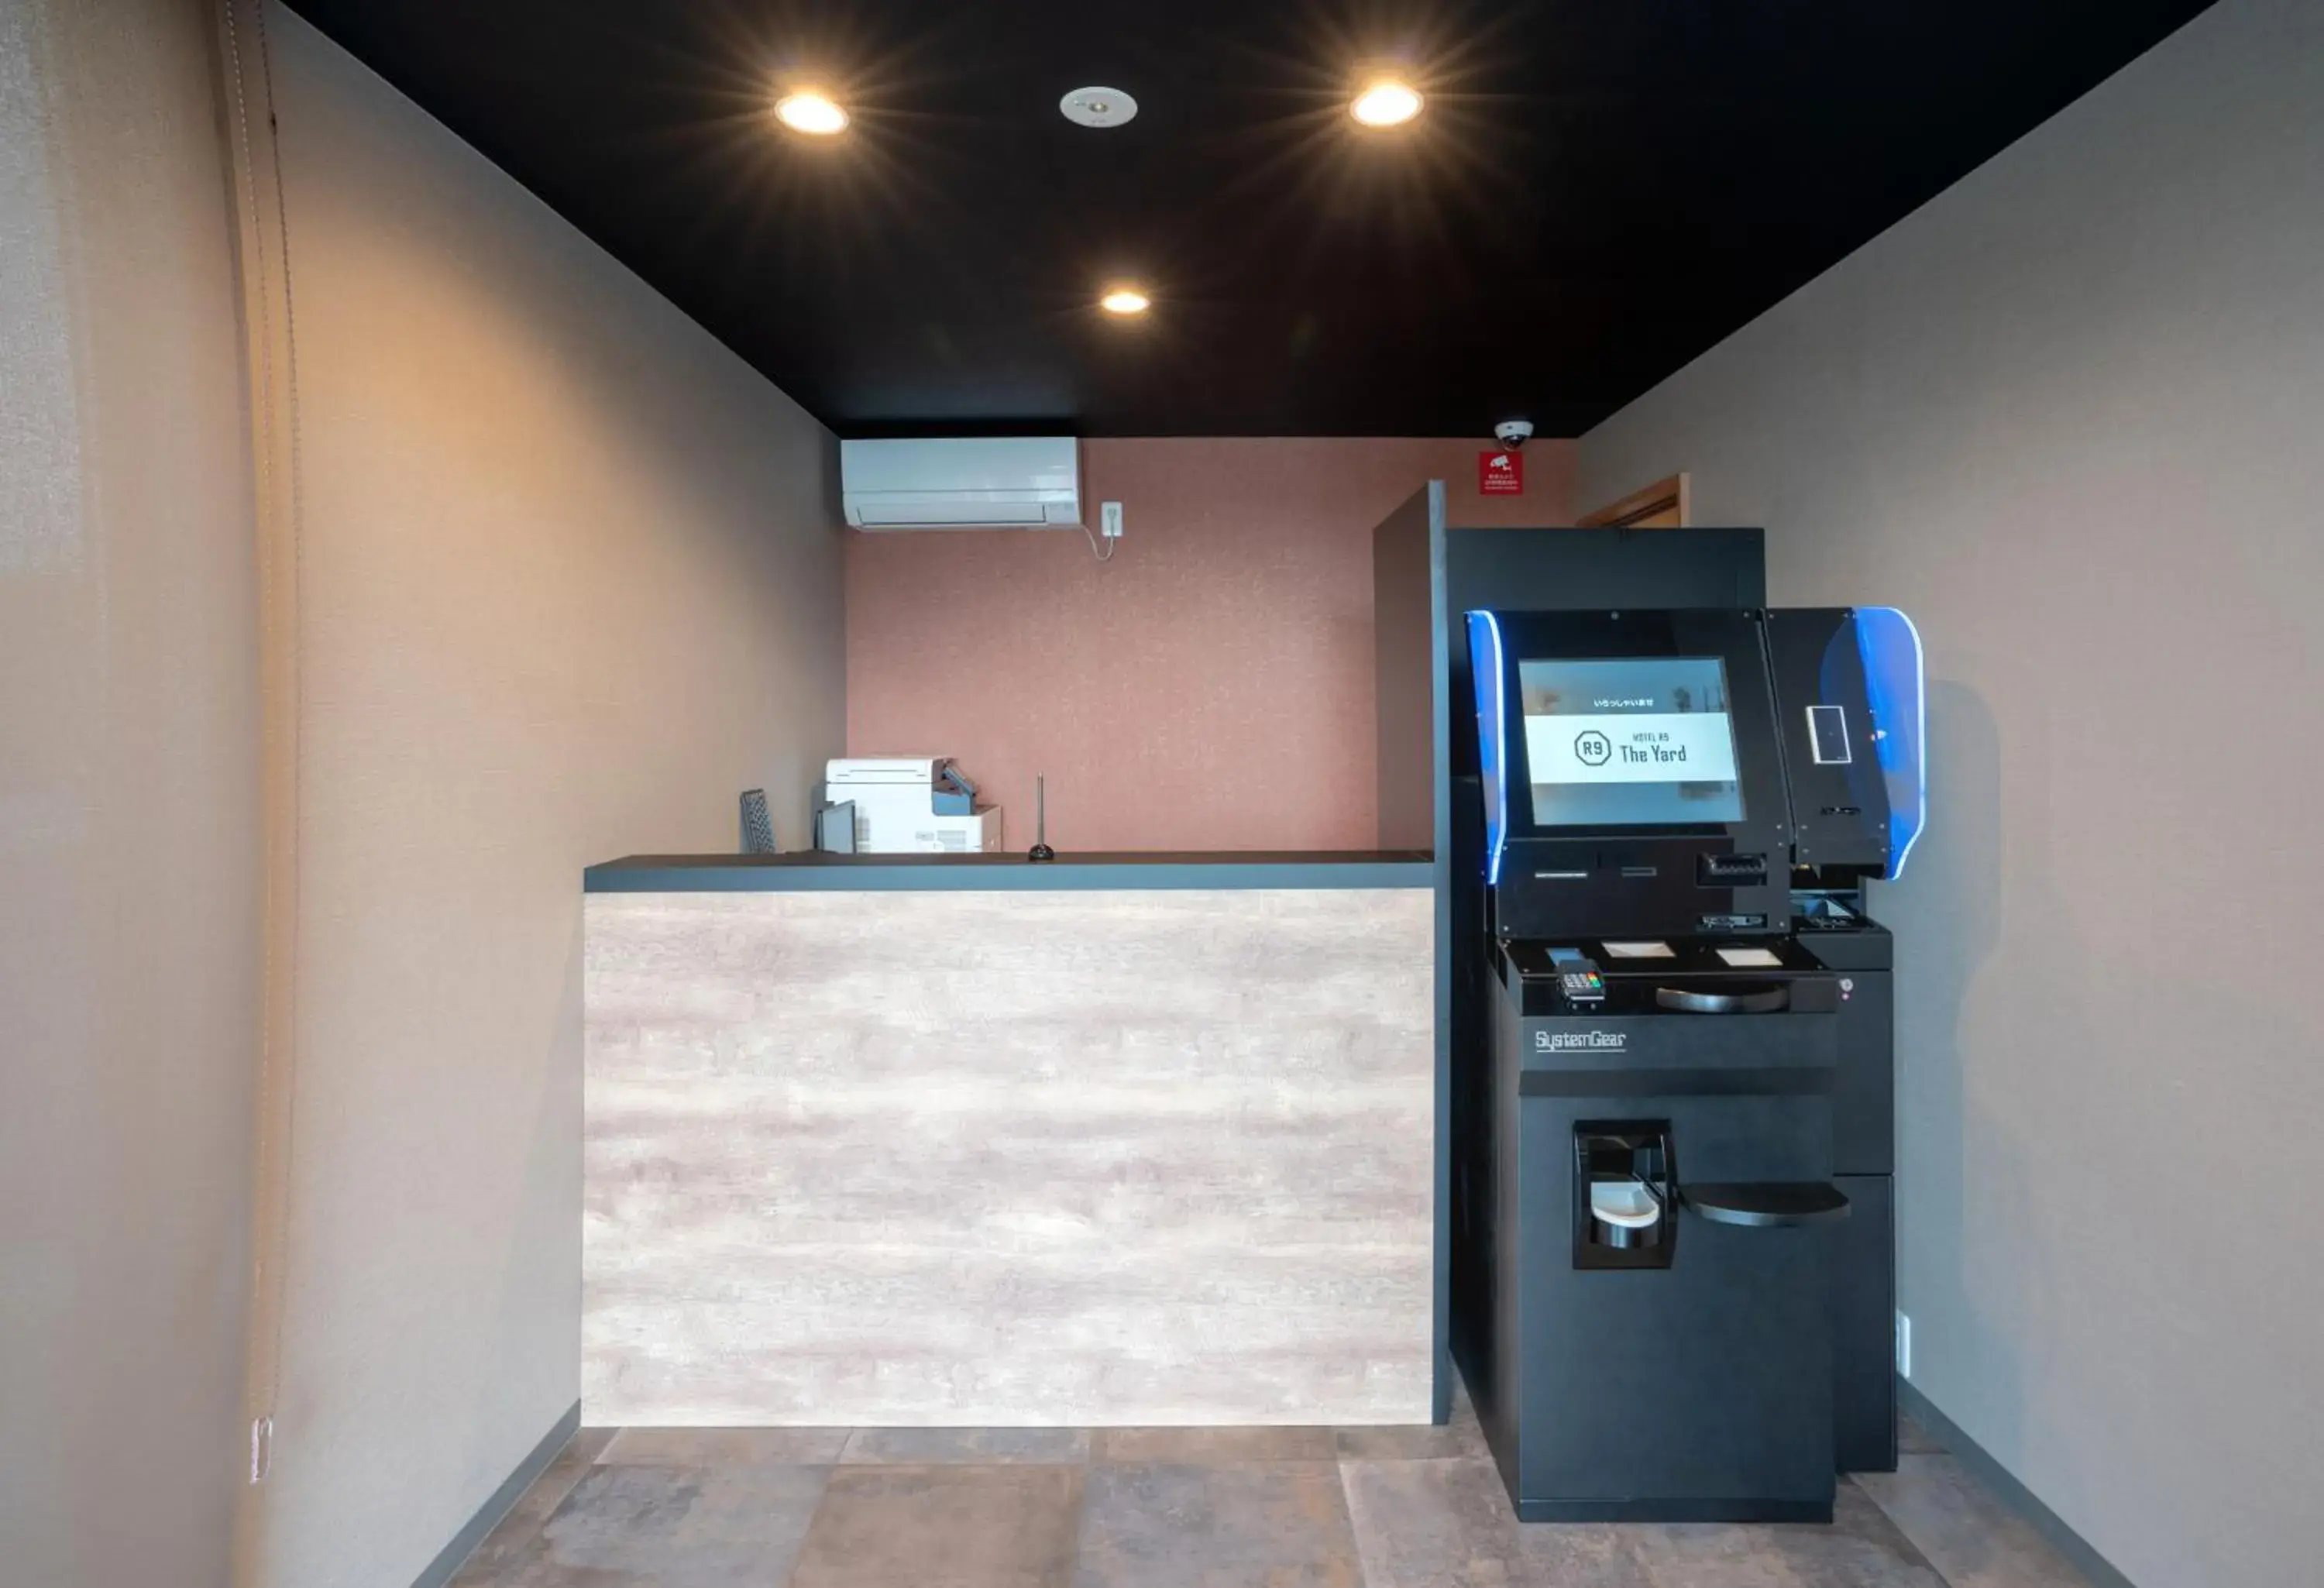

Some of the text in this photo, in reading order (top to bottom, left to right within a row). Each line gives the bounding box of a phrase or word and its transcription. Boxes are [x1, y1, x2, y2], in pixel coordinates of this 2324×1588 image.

[1593, 698, 1654, 707] いらっしゃいませ
[1583, 741, 1603, 755] R9
[1620, 744, 1687, 762] The Yard
[1535, 1030, 1627, 1051] SystemGear
